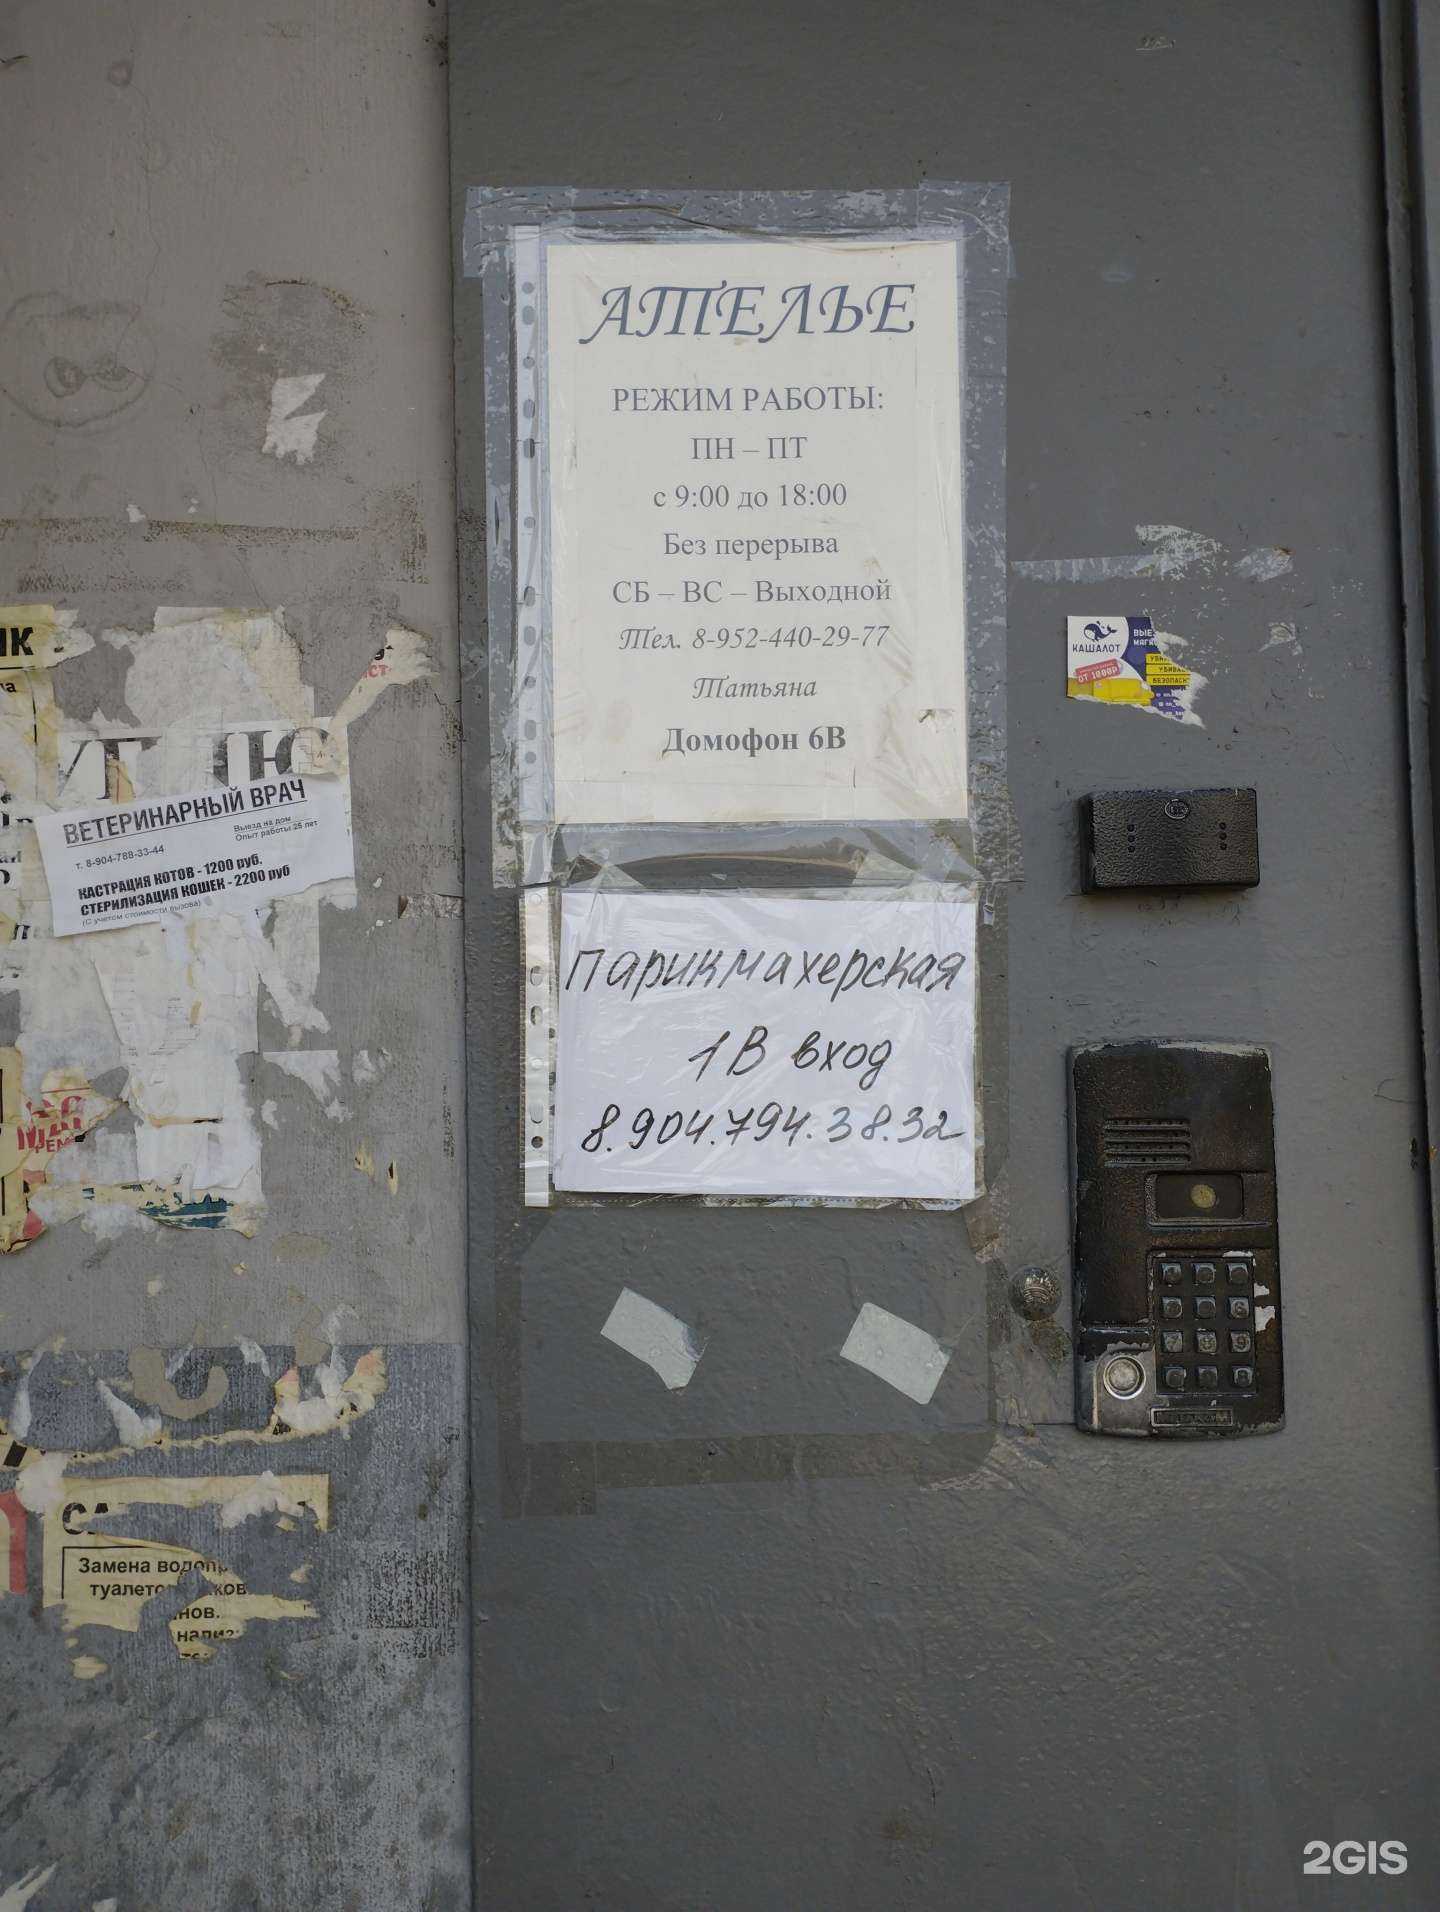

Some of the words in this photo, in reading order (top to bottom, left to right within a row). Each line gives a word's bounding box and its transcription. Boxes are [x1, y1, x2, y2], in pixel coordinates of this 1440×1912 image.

[578, 280, 916, 345] АТЕЛЬЕ
[612, 387, 733, 412] РЕЖИМ
[742, 385, 884, 411] РАБОТЫ:
[691, 437, 736, 460] ПН
[767, 436, 809, 459] ПТ
[653, 490, 666, 507] с
[675, 484, 730, 508] 9:00
[737, 490, 768, 510] до
[779, 482, 848, 507] 18:00
[663, 533, 707, 556] Без
[715, 536, 839, 560] перерыва
[612, 580, 651, 604] СБ
[683, 580, 723, 603] ВС
[755, 578, 892, 605] Выходной
[618, 626, 681, 650] Тел.
[692, 625, 890, 650] 8-952-440-29-77
[1072, 643, 1121, 653] КАШАЛОТ
[692, 676, 817, 700] Татьяна
[661, 727, 799, 757] Домофон
[808, 725, 847, 751] 6В
[63, 786, 244, 845] ВЕТЕРИНАРНЫЙ
[250, 779, 307, 808] ВРАЧ
[233, 822, 261, 832] Выезд
[263, 819, 274, 827] на
[235, 832, 259, 841] Опыт
[261, 825, 292, 838] работы
[86, 844, 165, 868] 8-904-788-33-44
[77, 874, 152, 901] КАСТРАЦИЯ
[154, 866, 195, 886] КОТОВ
[204, 858, 235, 875] 1200
[236, 853, 263, 870] руб.
[80, 887, 179, 916] СТЕРИЛИЗАЦИЯ
[181, 877, 226, 898] КОШЕК
[234, 869, 266, 887] 2200
[268, 863, 291, 881] руб
[565, 946, 967, 1002] Парикмахерская
[791, 1031, 892, 1091] вход
[78, 1556, 150, 1574] Замена
